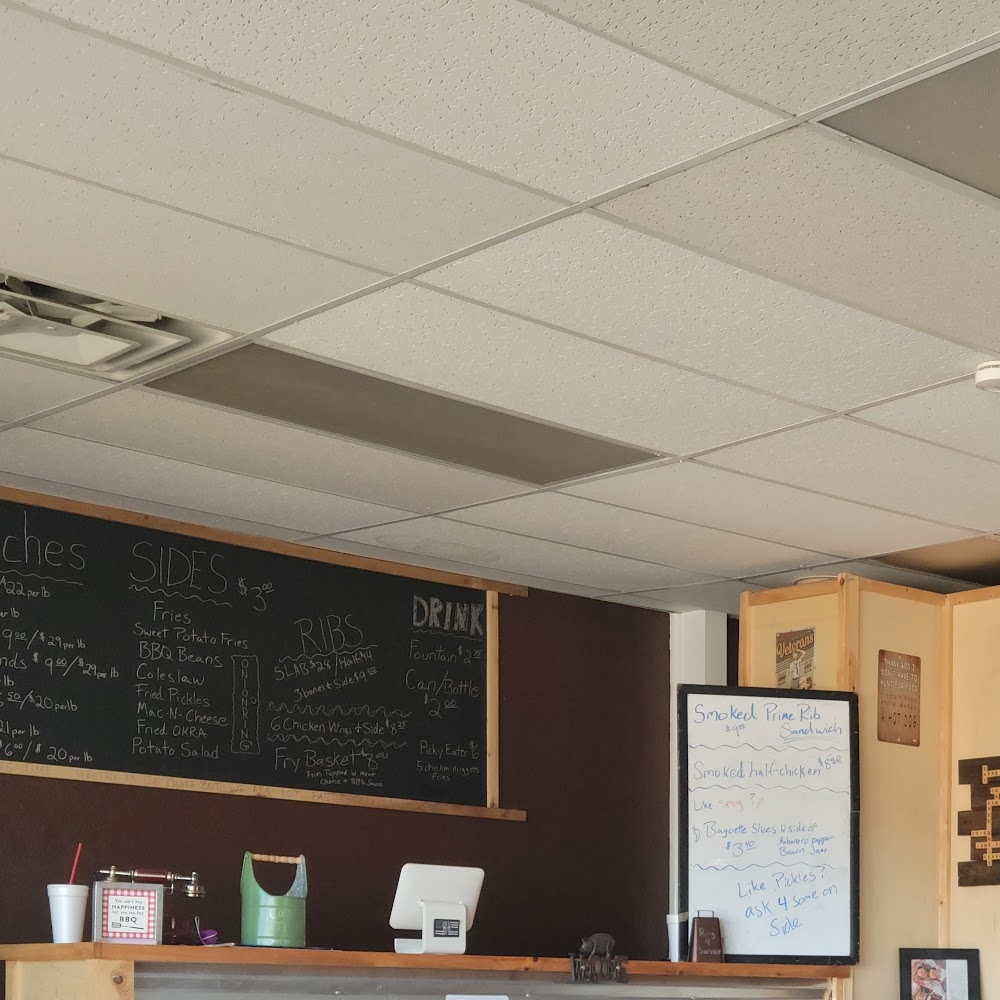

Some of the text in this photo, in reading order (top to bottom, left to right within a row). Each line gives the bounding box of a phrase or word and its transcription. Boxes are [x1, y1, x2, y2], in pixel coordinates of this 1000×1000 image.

[130, 541, 228, 594] SIDES
[27, 589, 40, 600] per
[41, 586, 51, 598] lb
[153, 600, 191, 624] Fries
[412, 595, 484, 636] DRINK
[133, 621, 248, 650] Sweet Potato Fries
[294, 614, 364, 653] RIBS
[63, 641, 75, 650] per
[139, 641, 223, 668] BBQ Beans
[409, 639, 457, 661] Fountain
[136, 662, 205, 685] Coleslaw
[273, 662, 310, 681] SLAB
[135, 683, 210, 707] Fried Pickles
[693, 703, 821, 723] Smoked Prime Rib
[12, 727, 26, 739] per
[137, 718, 208, 739] Fried OKRA
[270, 715, 280, 731] 6
[282, 717, 326, 734] Chicken
[328, 720, 352, 737] Wings
[362, 721, 385, 736] Side
[779, 721, 842, 739] Sandwich
[132, 736, 220, 760] Potato Salad
[420, 739, 443, 759] Picky
[445, 743, 468, 757] Eater
[275, 747, 300, 773] Fry
[304, 748, 360, 768] Basket
[693, 761, 745, 780] Smoked
[749, 761, 778, 778] half
[780, 760, 821, 777] chicken
[432, 772, 450, 781] Fries
[693, 800, 713, 812] Like
[703, 820, 748, 838] Baguette
[751, 821, 777, 834] Slices
[738, 880, 767, 898] Like
[744, 884, 838, 919] ask 4 some on
[119, 916, 138, 924] BBQ
[770, 916, 803, 938] Side
